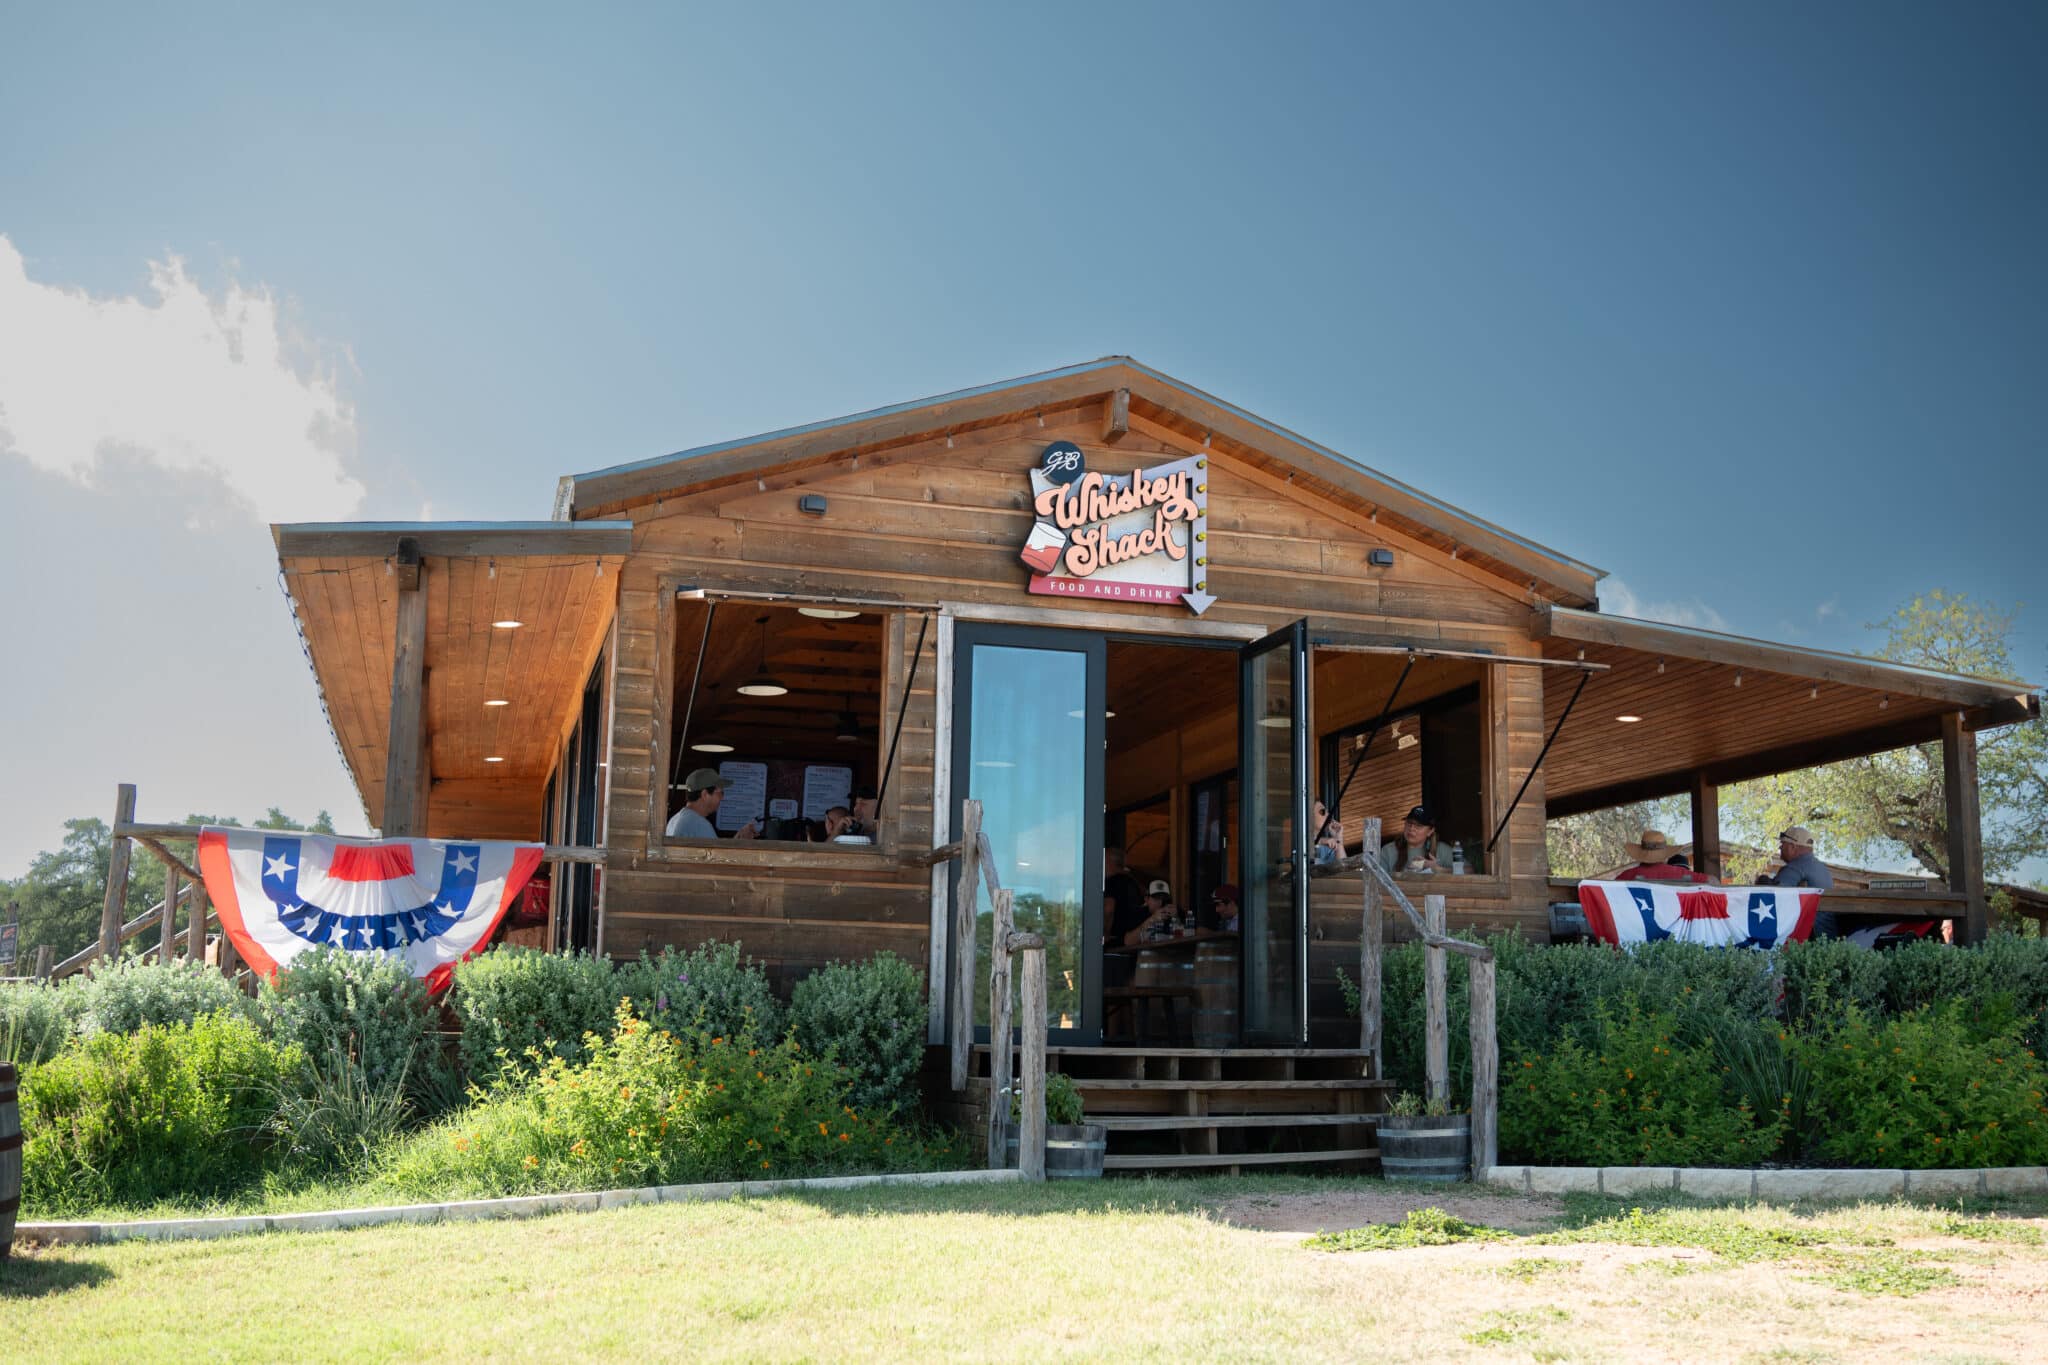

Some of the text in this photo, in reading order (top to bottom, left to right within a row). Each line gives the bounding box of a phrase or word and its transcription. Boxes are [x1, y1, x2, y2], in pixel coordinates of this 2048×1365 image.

[1035, 468, 1199, 529] Whiskey
[1065, 510, 1186, 577] Shack
[1050, 583, 1172, 600] FOOD AND DRINK
